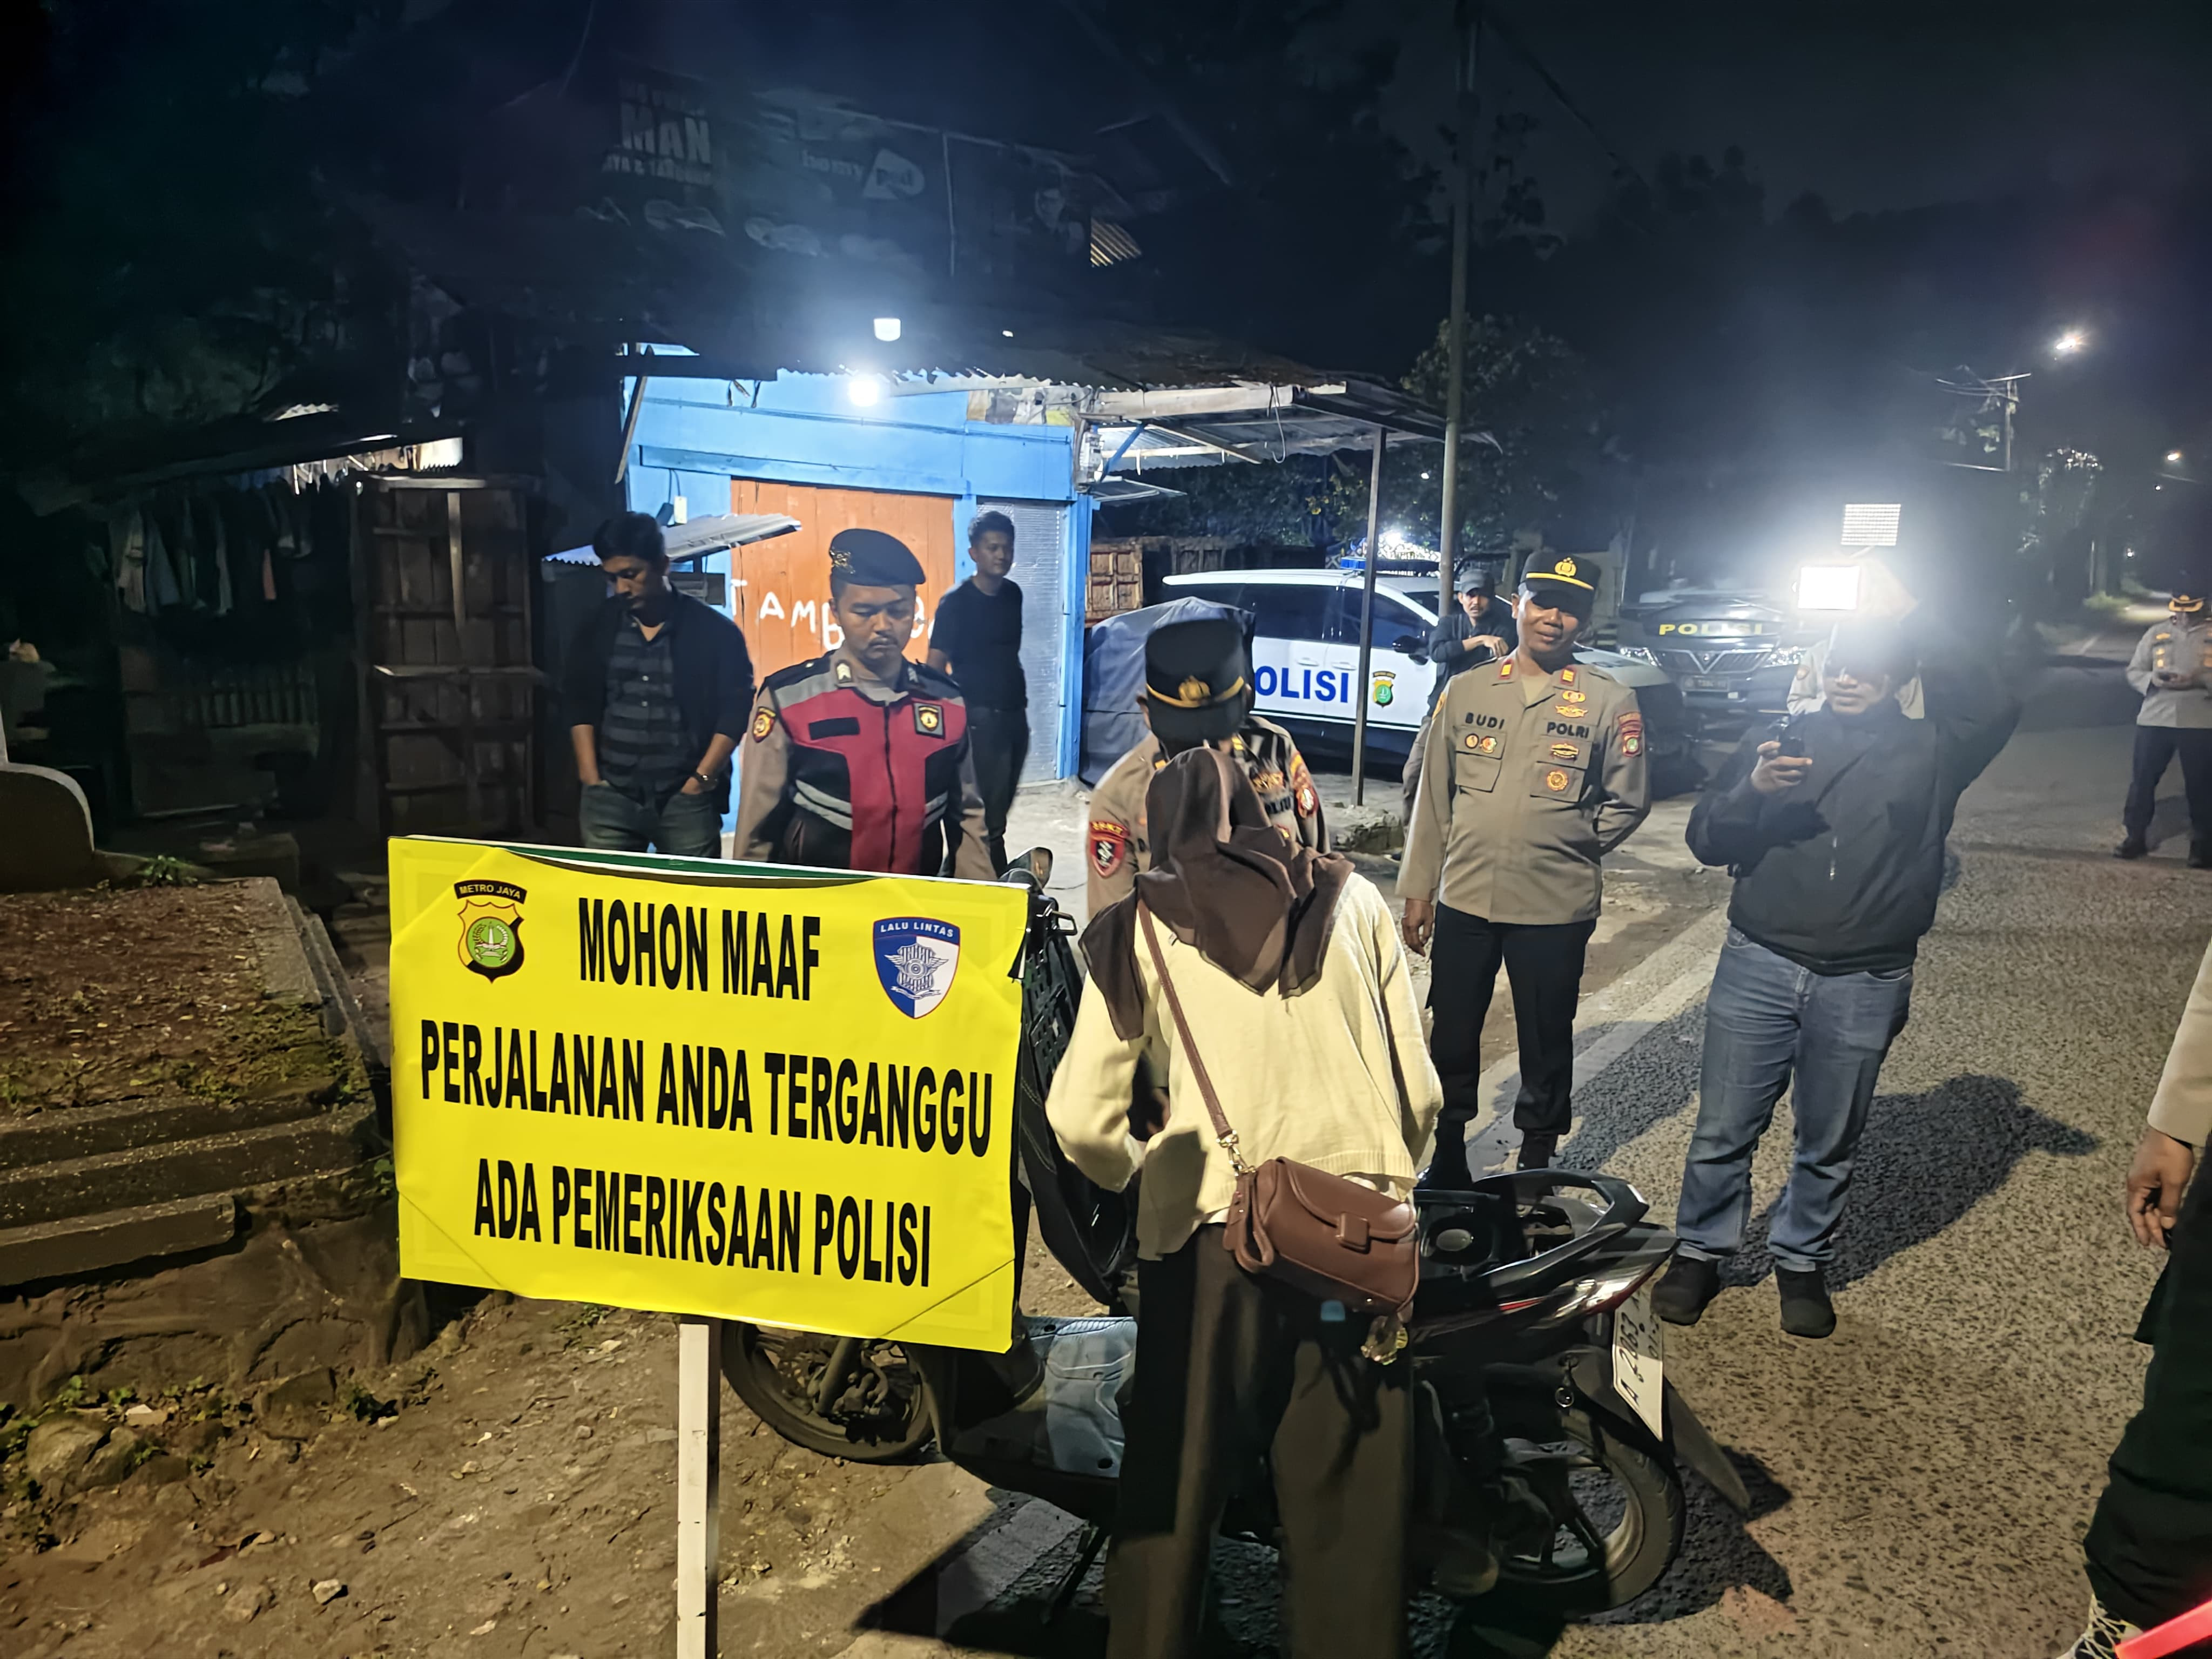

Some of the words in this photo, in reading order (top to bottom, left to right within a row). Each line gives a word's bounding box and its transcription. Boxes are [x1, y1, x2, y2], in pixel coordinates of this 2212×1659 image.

[1255, 665, 1348, 703] OLISI
[1465, 712, 1505, 730] BUDI
[1547, 721, 1589, 739] POLRI
[459, 884, 494, 894] METRO
[496, 886, 521, 899] JAYA
[880, 922, 909, 933] LALU
[913, 922, 954, 938] LINTAS
[579, 898, 707, 991] MOHON
[723, 910, 820, 1000] MAAF
[422, 1020, 643, 1121] PERJALANAN
[657, 1043, 752, 1132] ANDA
[765, 1053, 992, 1157] TERGANGGU
[475, 1159, 541, 1242] ADA
[553, 1166, 800, 1273] PEMERIKSAAN
[814, 1194, 930, 1287] POLISI
